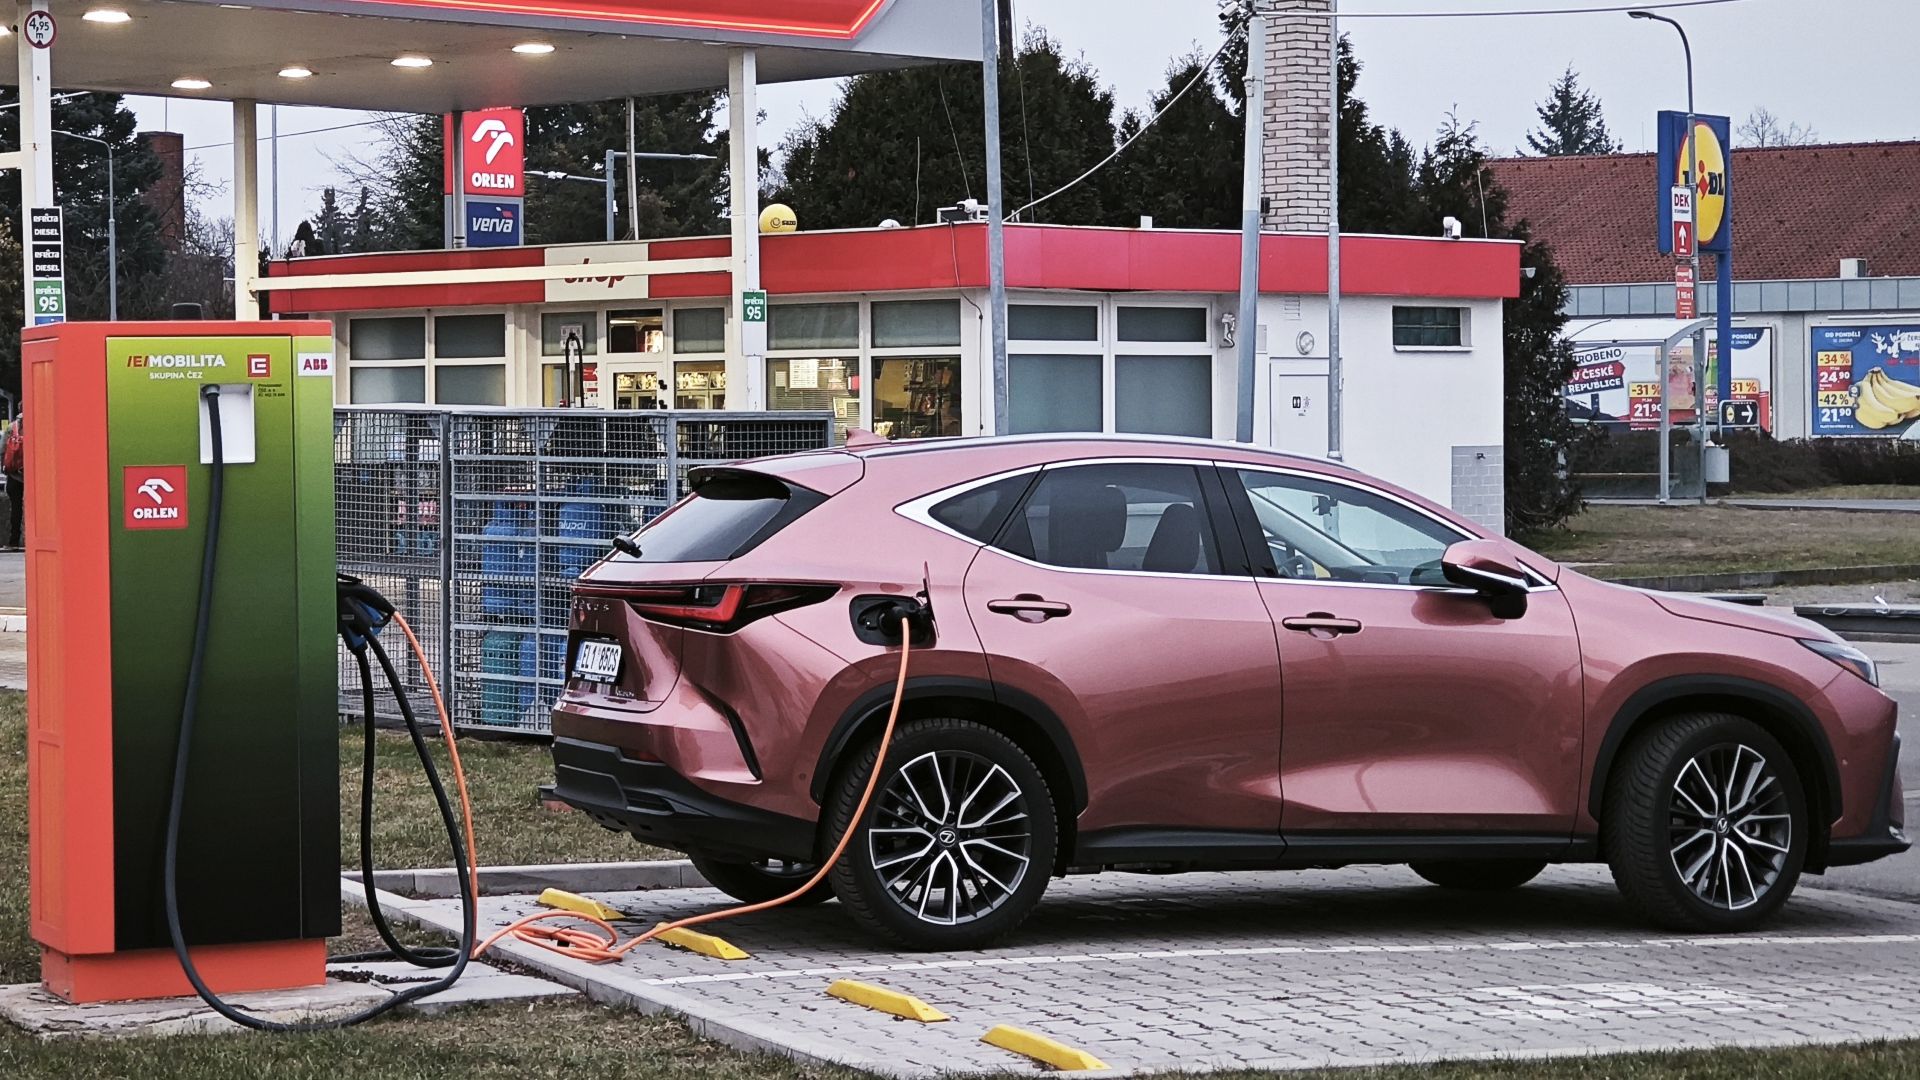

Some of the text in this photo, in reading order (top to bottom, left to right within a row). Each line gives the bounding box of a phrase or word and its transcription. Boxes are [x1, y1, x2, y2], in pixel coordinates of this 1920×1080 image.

[29, 17, 50, 32] 4,95
[471, 172, 515, 189] ORLEN
[1674, 193, 1690, 208] DEK
[472, 216, 514, 233] verva
[34, 228, 59, 236] DIESEL
[35, 264, 60, 272] DIESEL
[39, 296, 59, 311] 95
[746, 306, 762, 320] 95
[1573, 348, 1622, 364] ROBENO
[1819, 353, 1850, 365] -34 %
[303, 358, 328, 371] ABB
[187, 370, 203, 379] ČEZ
[1582, 364, 1615, 380] ČESKÉ
[1567, 377, 1622, 394] REPUBLICE
[1631, 384, 1662, 395] -31 %
[1731, 382, 1757, 392] 31 %
[1819, 393, 1849, 405] -42 %
[133, 507, 178, 519] ORLEN
